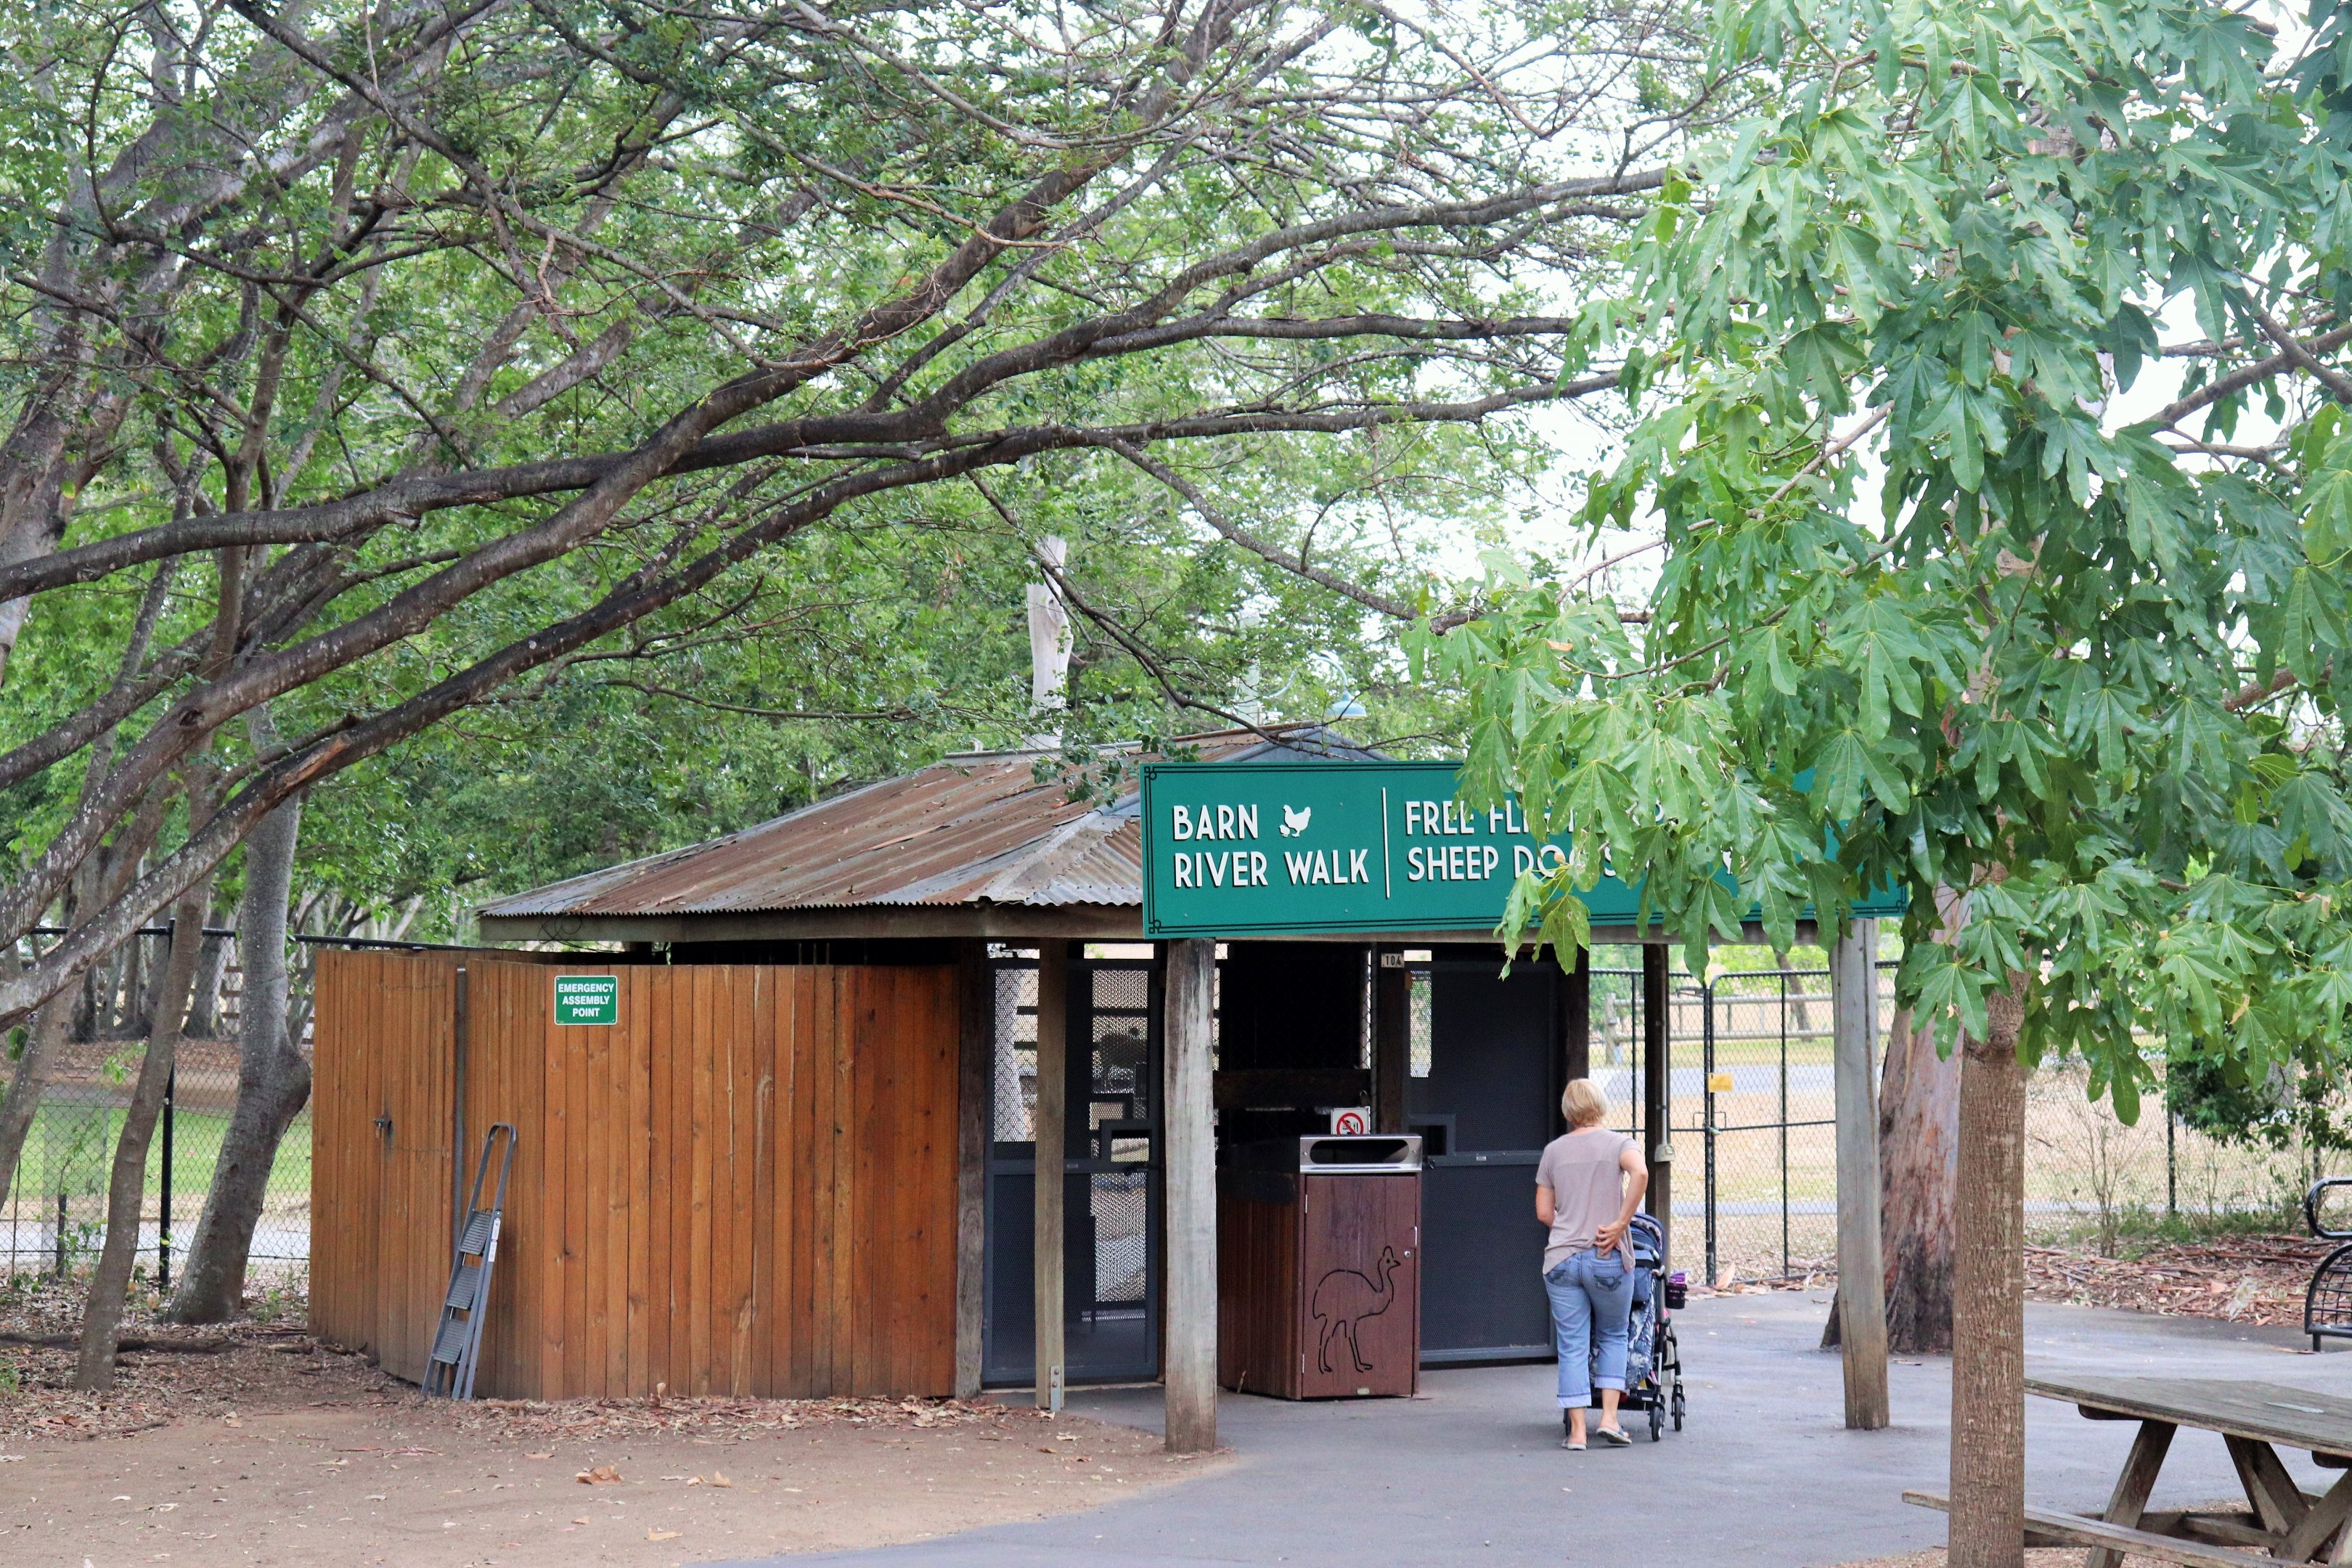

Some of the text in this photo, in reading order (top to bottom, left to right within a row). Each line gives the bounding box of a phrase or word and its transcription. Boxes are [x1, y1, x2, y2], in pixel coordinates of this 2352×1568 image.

[1173, 804, 1259, 841] BARN
[1405, 800, 1475, 835] FREE
[1175, 849, 1370, 888] RIVER WALK
[1408, 845, 1499, 881] SHEEP
[1386, 955, 1401, 965] 104
[558, 983, 614, 992] EMERGENCY
[562, 995, 610, 1005] ASSEMBLY
[572, 1008, 600, 1017] POINT
